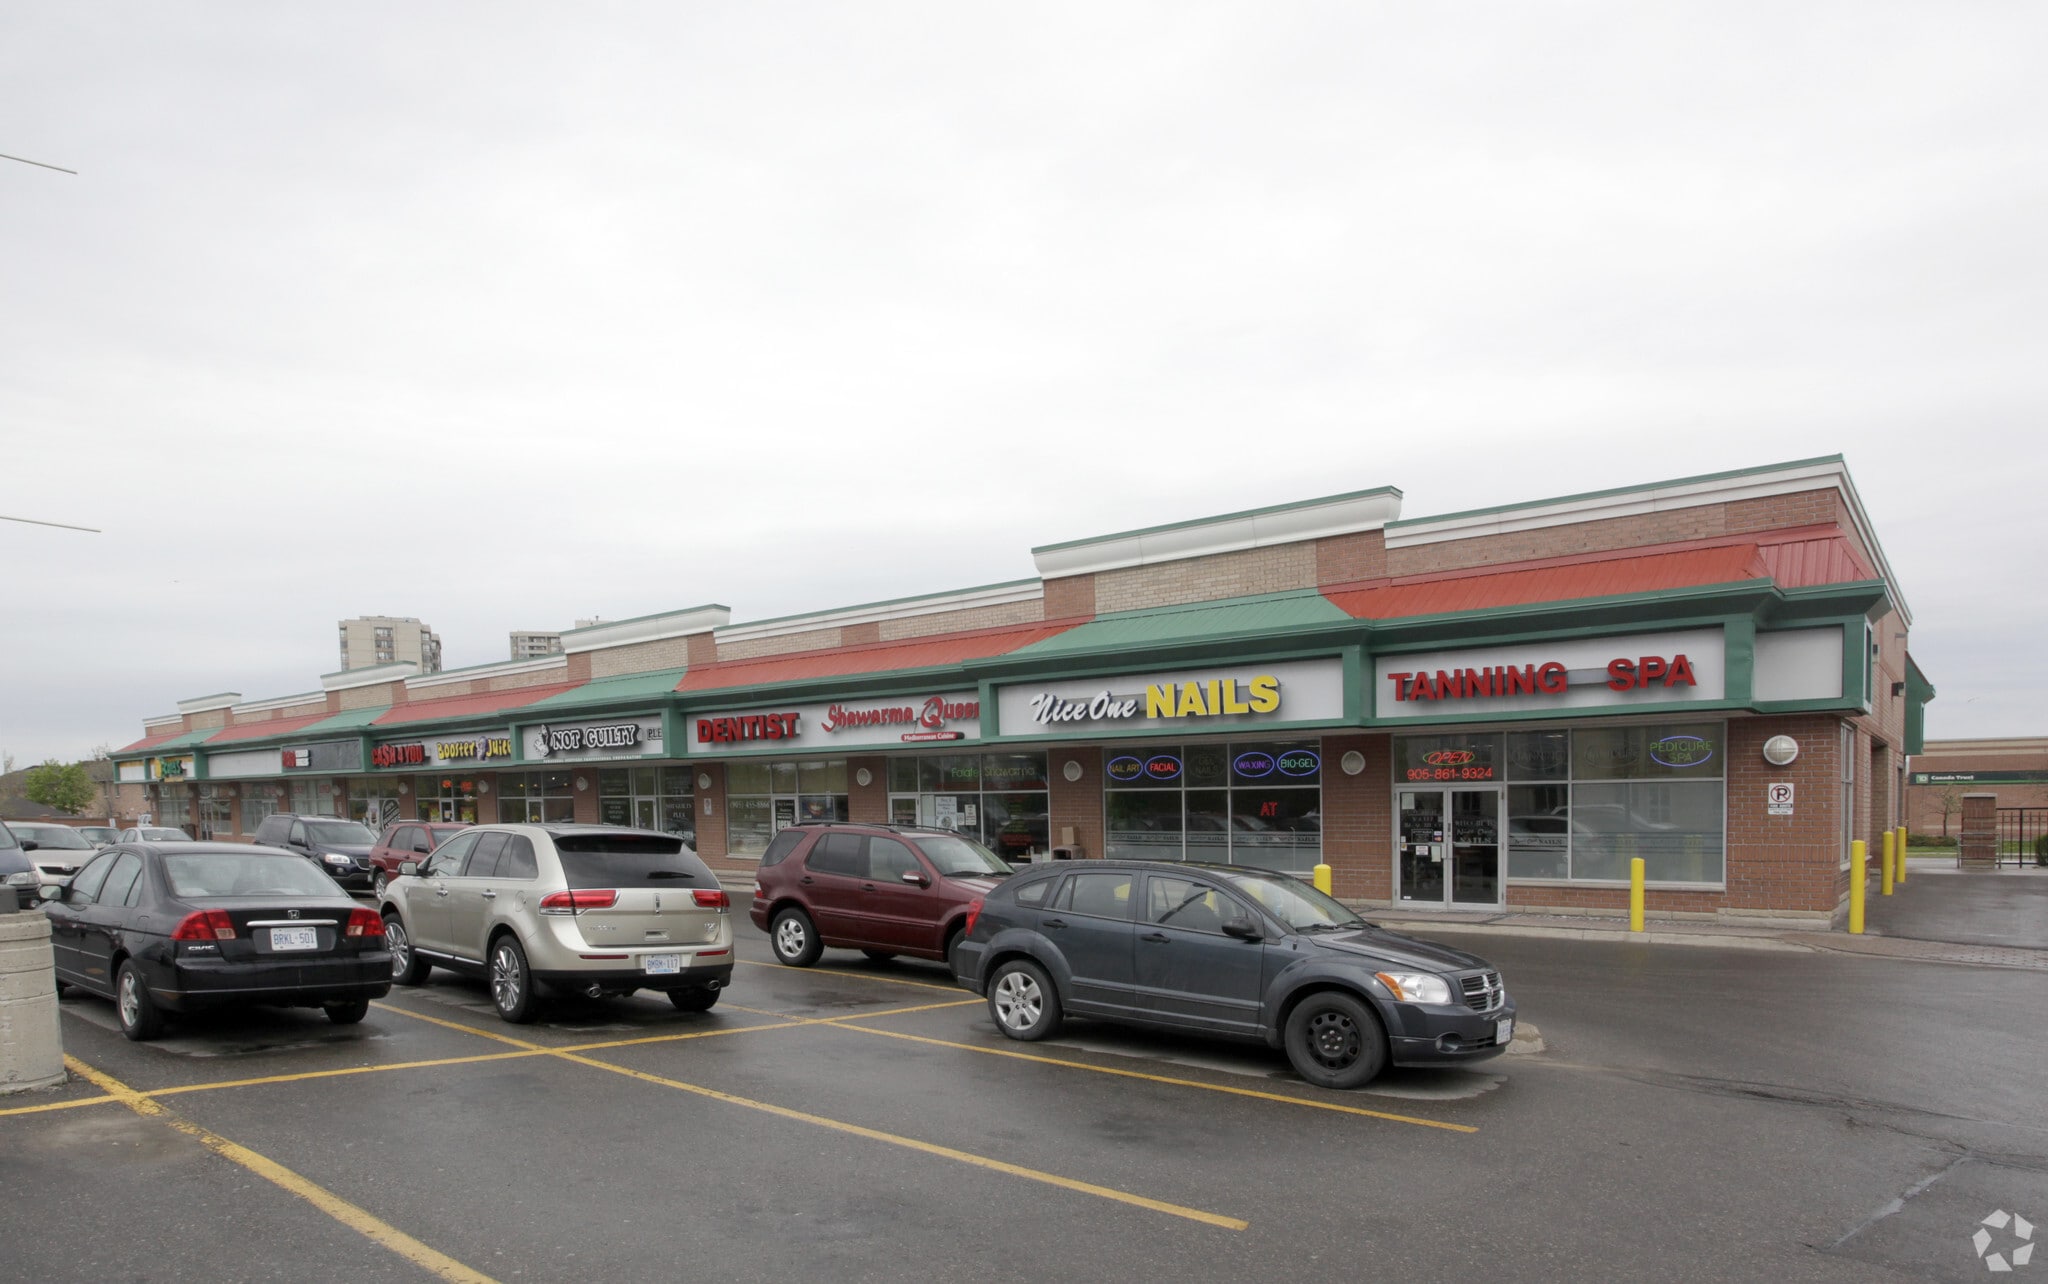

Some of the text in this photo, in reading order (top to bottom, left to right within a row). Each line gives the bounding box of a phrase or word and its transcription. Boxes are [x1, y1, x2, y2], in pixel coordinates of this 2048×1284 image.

[1387, 653, 1698, 702] TANNING SPA
[1029, 674, 1281, 726] Nice One NAILS
[821, 703, 914, 733] Shawarma
[697, 711, 799, 744] DENTIST
[551, 730, 580, 750] NOT
[585, 724, 637, 748] GUILTY
[1649, 740, 1713, 753] PEDICURE
[1238, 759, 1271, 769] WAXING
[1280, 758, 1316, 769] BIO-GEL
[1427, 751, 1473, 765] OPEN
[1668, 752, 1693, 764] SPA
[951, 767, 980, 778] Falafe
[1149, 762, 1177, 772] FACIAL
[1407, 767, 1493, 780] 905-861-9324
[1260, 802, 1278, 816] AT
